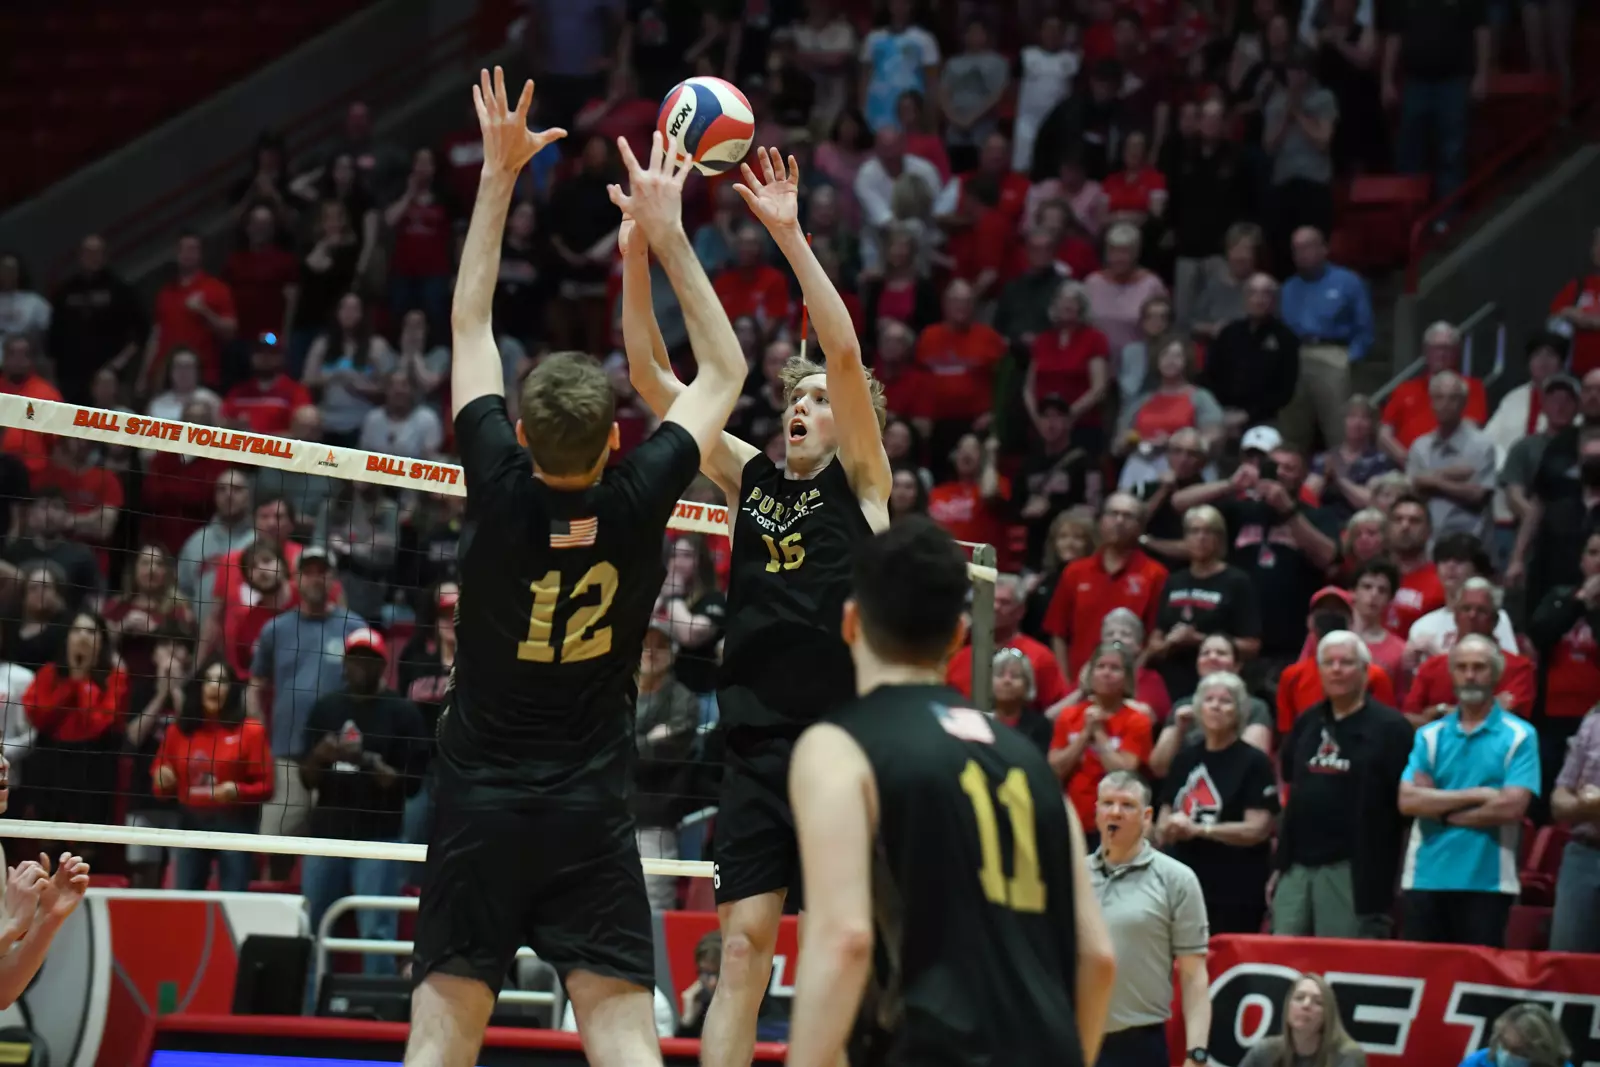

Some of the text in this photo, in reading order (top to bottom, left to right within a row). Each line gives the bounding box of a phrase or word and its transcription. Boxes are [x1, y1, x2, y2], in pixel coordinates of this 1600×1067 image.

[669, 103, 692, 137] NCAA
[72, 408, 294, 459] BALL STATE VOLLEYBALL
[365, 454, 406, 477] BALL
[750, 508, 777, 532] FORT
[761, 532, 806, 573] 16
[517, 560, 619, 664] 12
[959, 758, 1047, 913] 11
